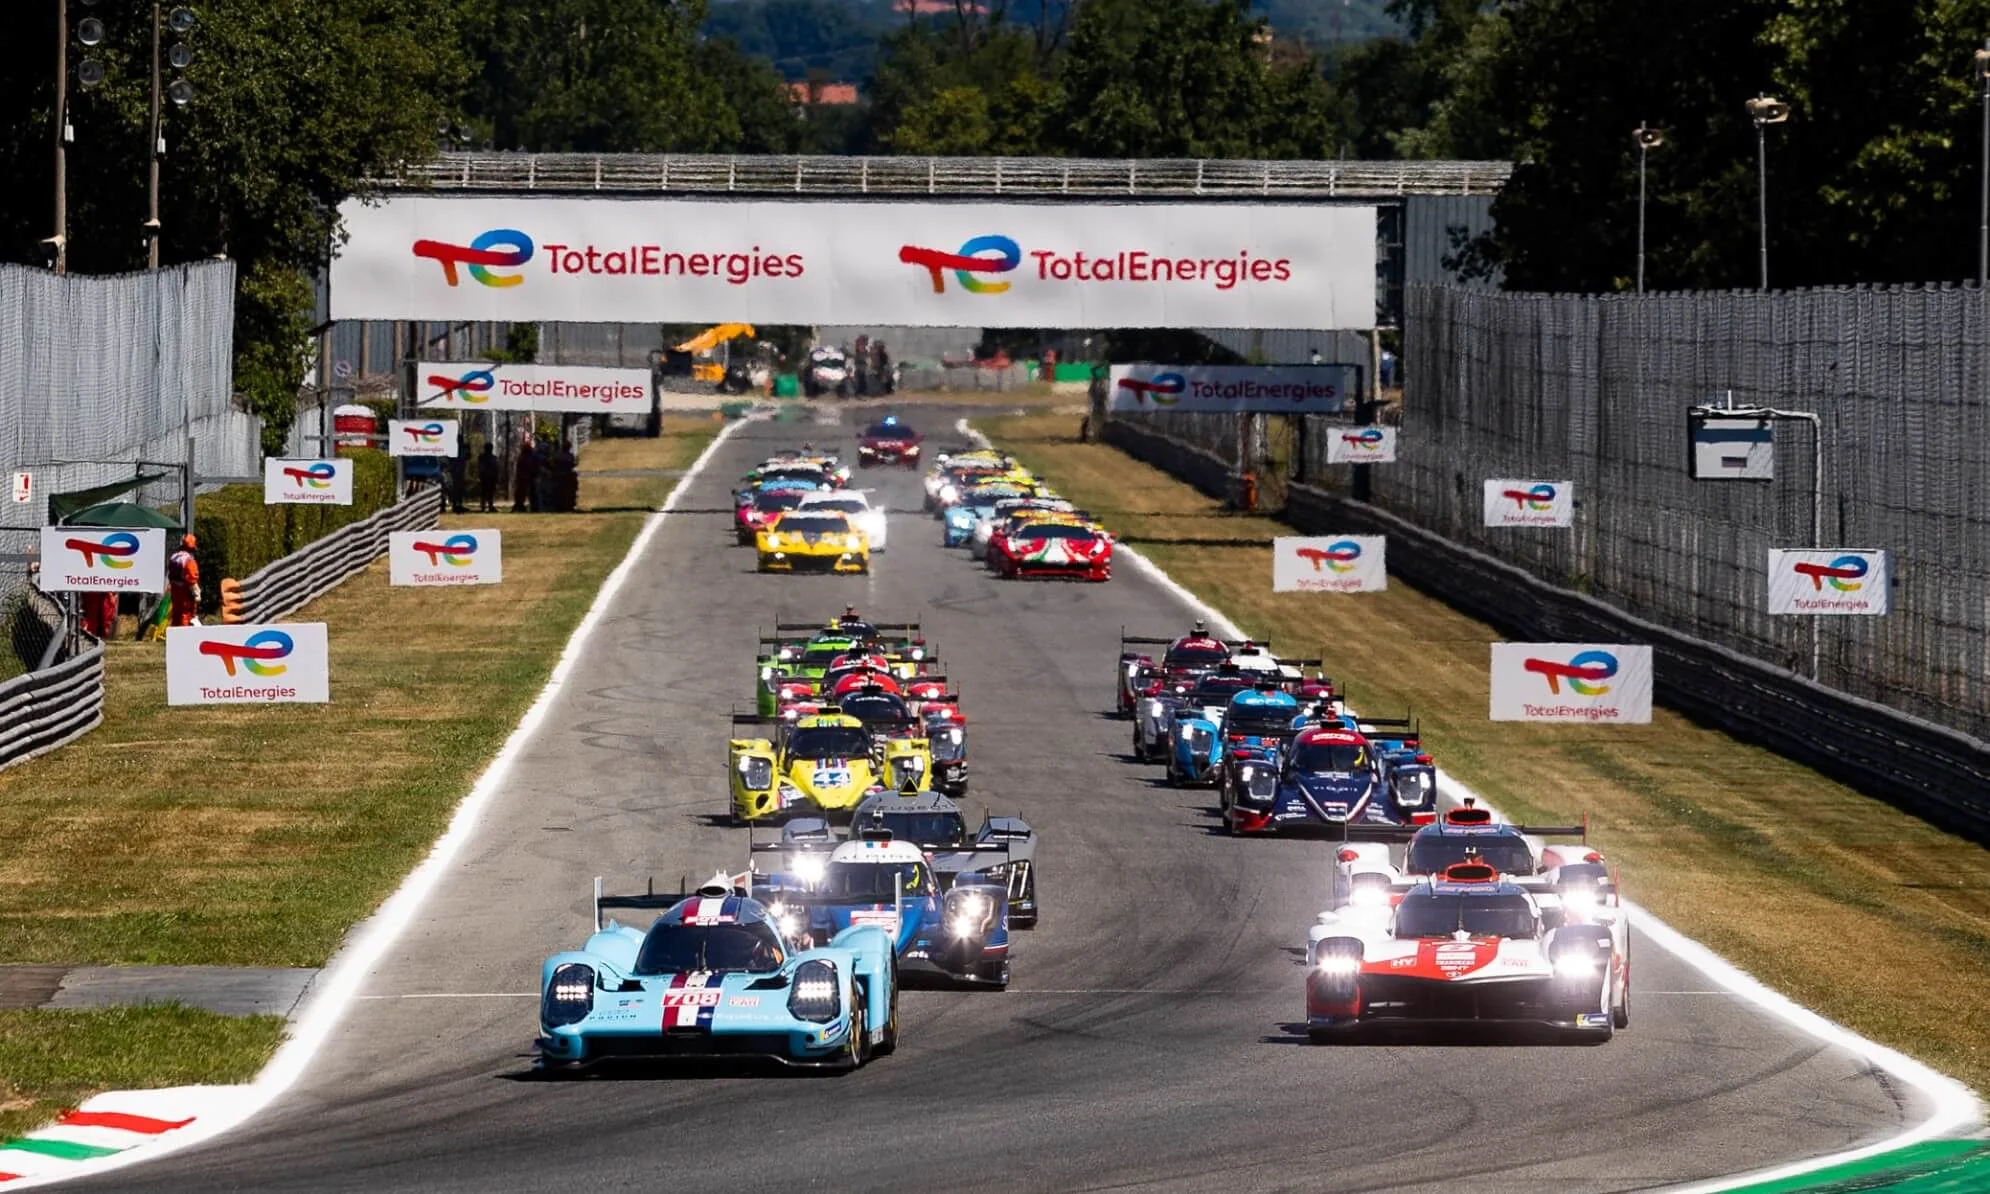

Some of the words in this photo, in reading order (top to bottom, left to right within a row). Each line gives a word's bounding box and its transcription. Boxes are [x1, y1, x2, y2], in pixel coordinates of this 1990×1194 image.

[543, 244, 804, 285] TotalEnergies
[1030, 250, 1291, 290] TotalEnergies
[500, 379, 644, 404] TotalEnergies
[1191, 380, 1335, 403] TotalEnergies
[64, 575, 140, 588] TotalEnergies
[1793, 598, 1869, 611] TotalEnergies
[200, 684, 296, 701] TotalEnergies
[1523, 703, 1619, 721] TotalEnergies
[665, 992, 719, 1006] 708
